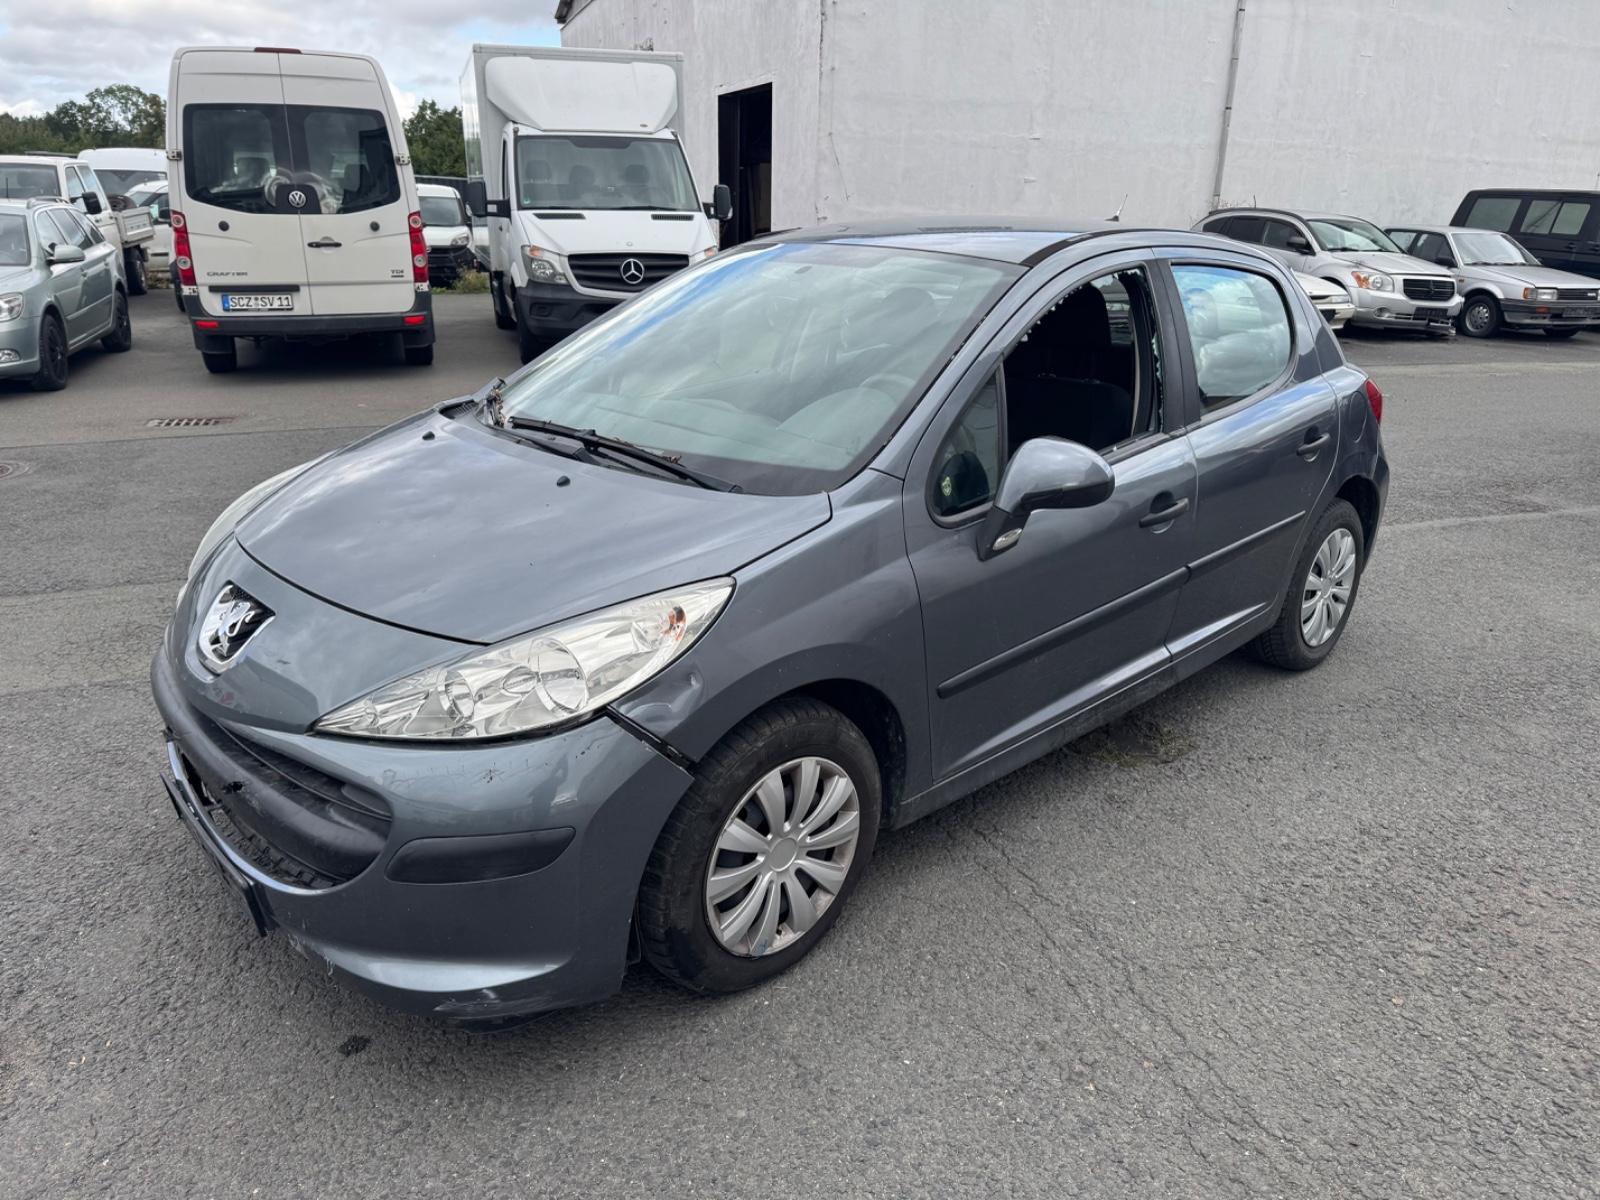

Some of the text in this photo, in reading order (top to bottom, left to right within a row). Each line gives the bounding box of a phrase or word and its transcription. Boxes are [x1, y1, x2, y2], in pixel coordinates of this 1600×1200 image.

[230, 296, 291, 308] SCZ SV 11
